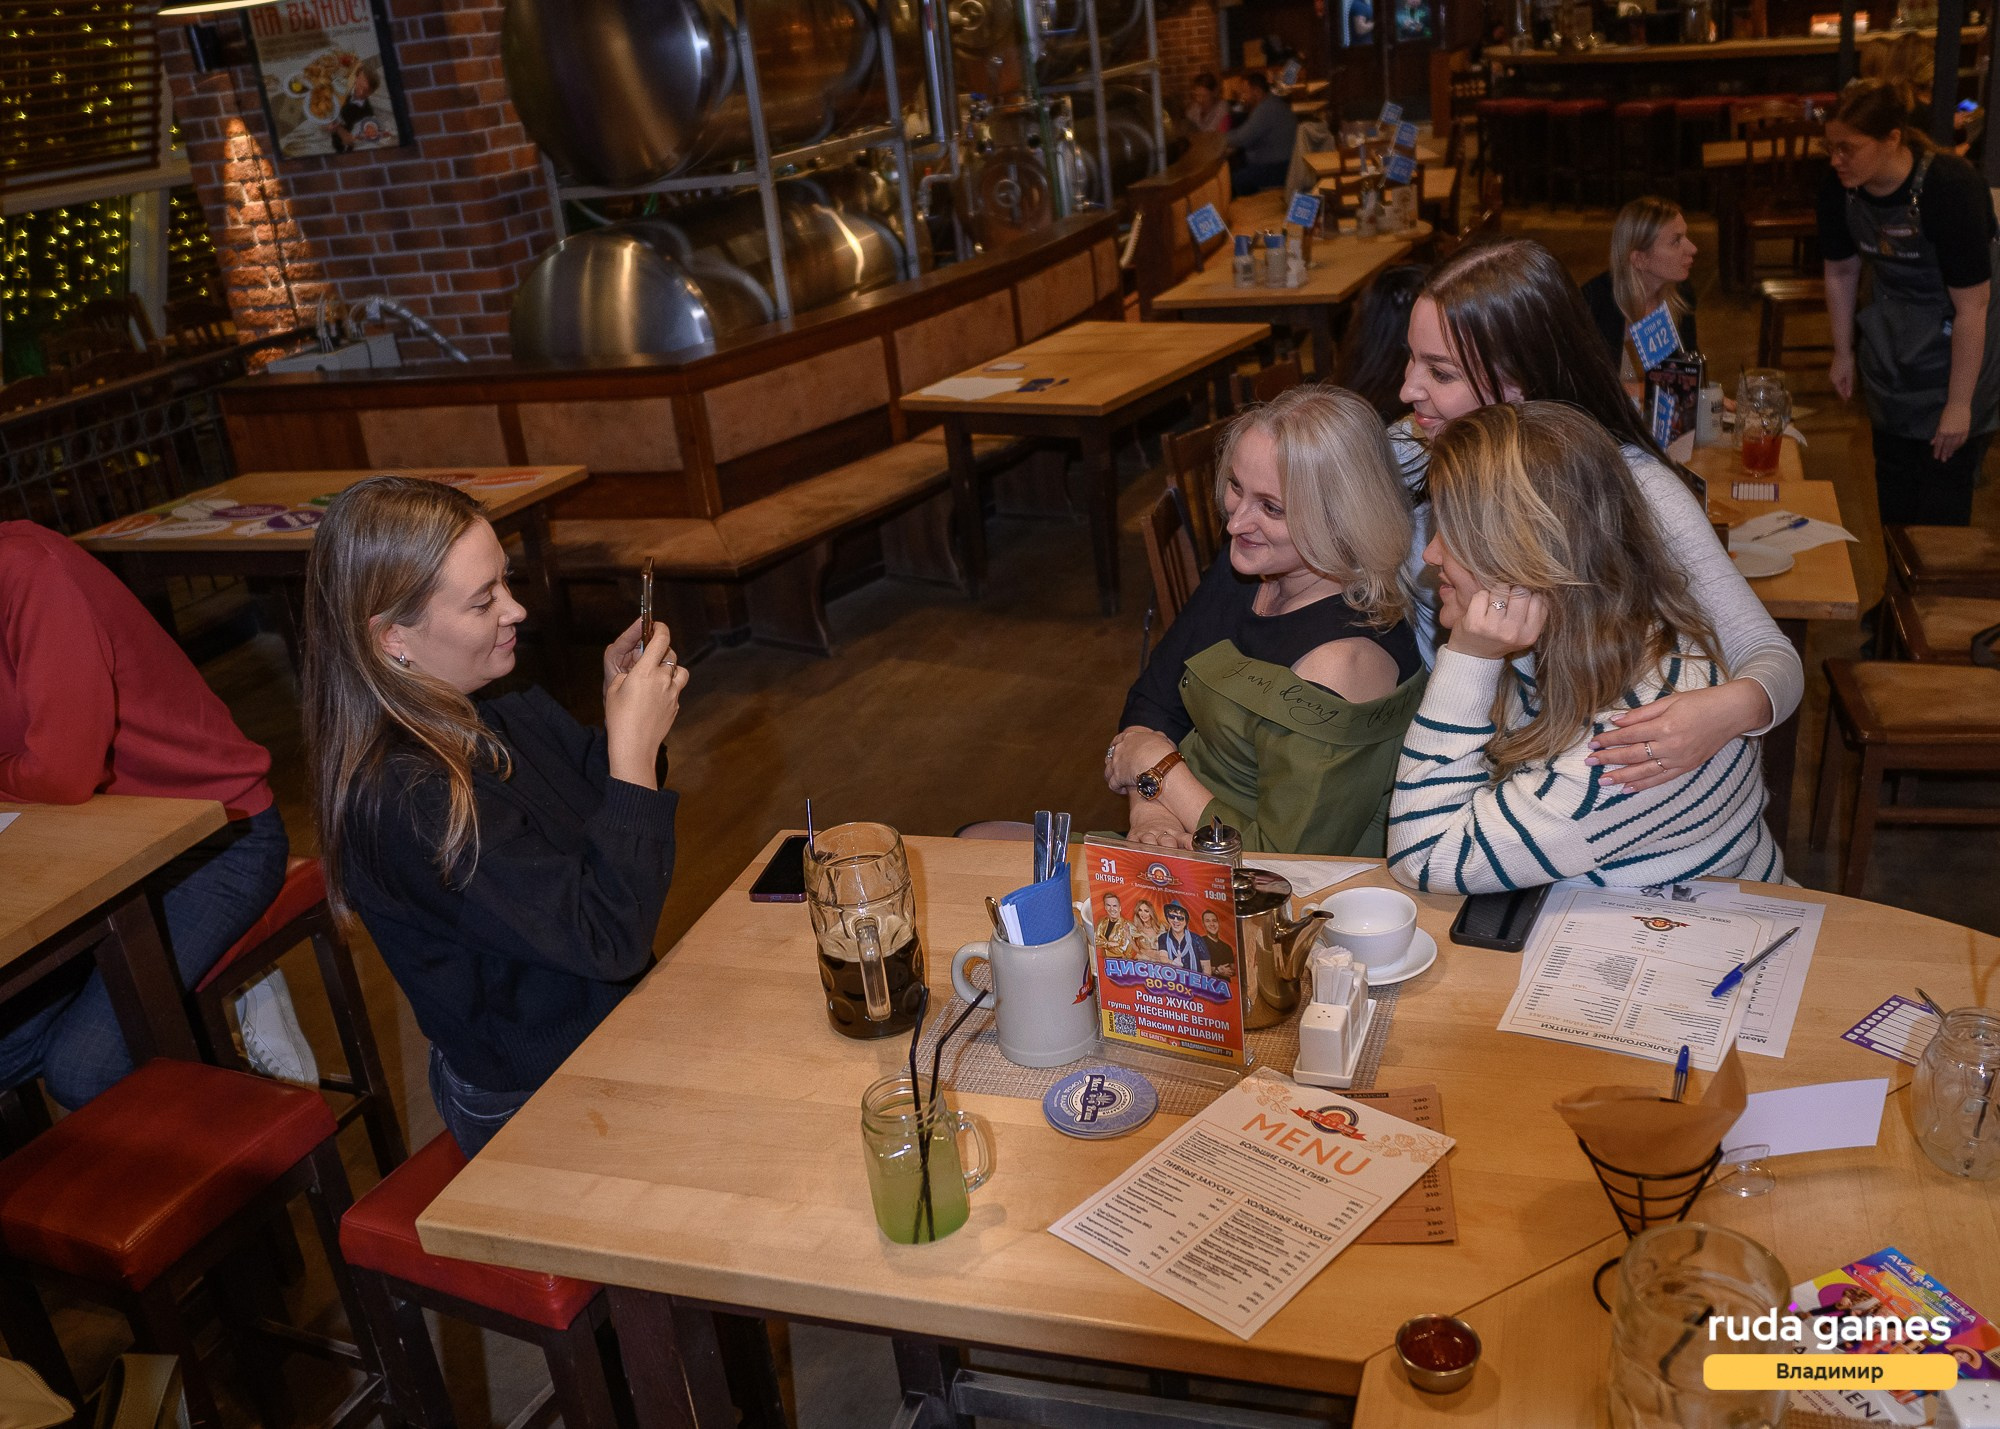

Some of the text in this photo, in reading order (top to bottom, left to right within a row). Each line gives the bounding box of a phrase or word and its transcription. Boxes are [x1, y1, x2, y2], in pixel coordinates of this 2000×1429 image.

[1648, 327, 1670, 353] 412
[1095, 873, 1124, 885] ОКТЯБРЯ
[1101, 858, 1117, 874] 31
[1204, 890, 1227, 902] 19:00
[1105, 959, 1232, 998] ДИСКОТЕКА
[1107, 1000, 1230, 1031] группа УНЕСЕННЫЕ ВЕТРОМ
[1136, 990, 1204, 1013] Рома ЖУКОВ
[1138, 1016, 1225, 1043] Максим АРШАВИН
[1539, 1023, 1679, 1054] ЕЗАЛКОГОЛЬНЫЕ НАПИТКИ
[1242, 1113, 1371, 1176] MENU
[1163, 1159, 1235, 1197] ПИВНЫЕ ЗАКУСКИ
[1239, 1140, 1332, 1185] БОЛЬШИЕ СЕТЫ К ПИВУ
[1244, 1197, 1293, 1226] ХОЛОДНЫЕ
[1291, 1220, 1333, 1243] ЗАКУСКИ
[1887, 1254, 1934, 1289] AVATAR
[1932, 1289, 1977, 1323] ARENA
